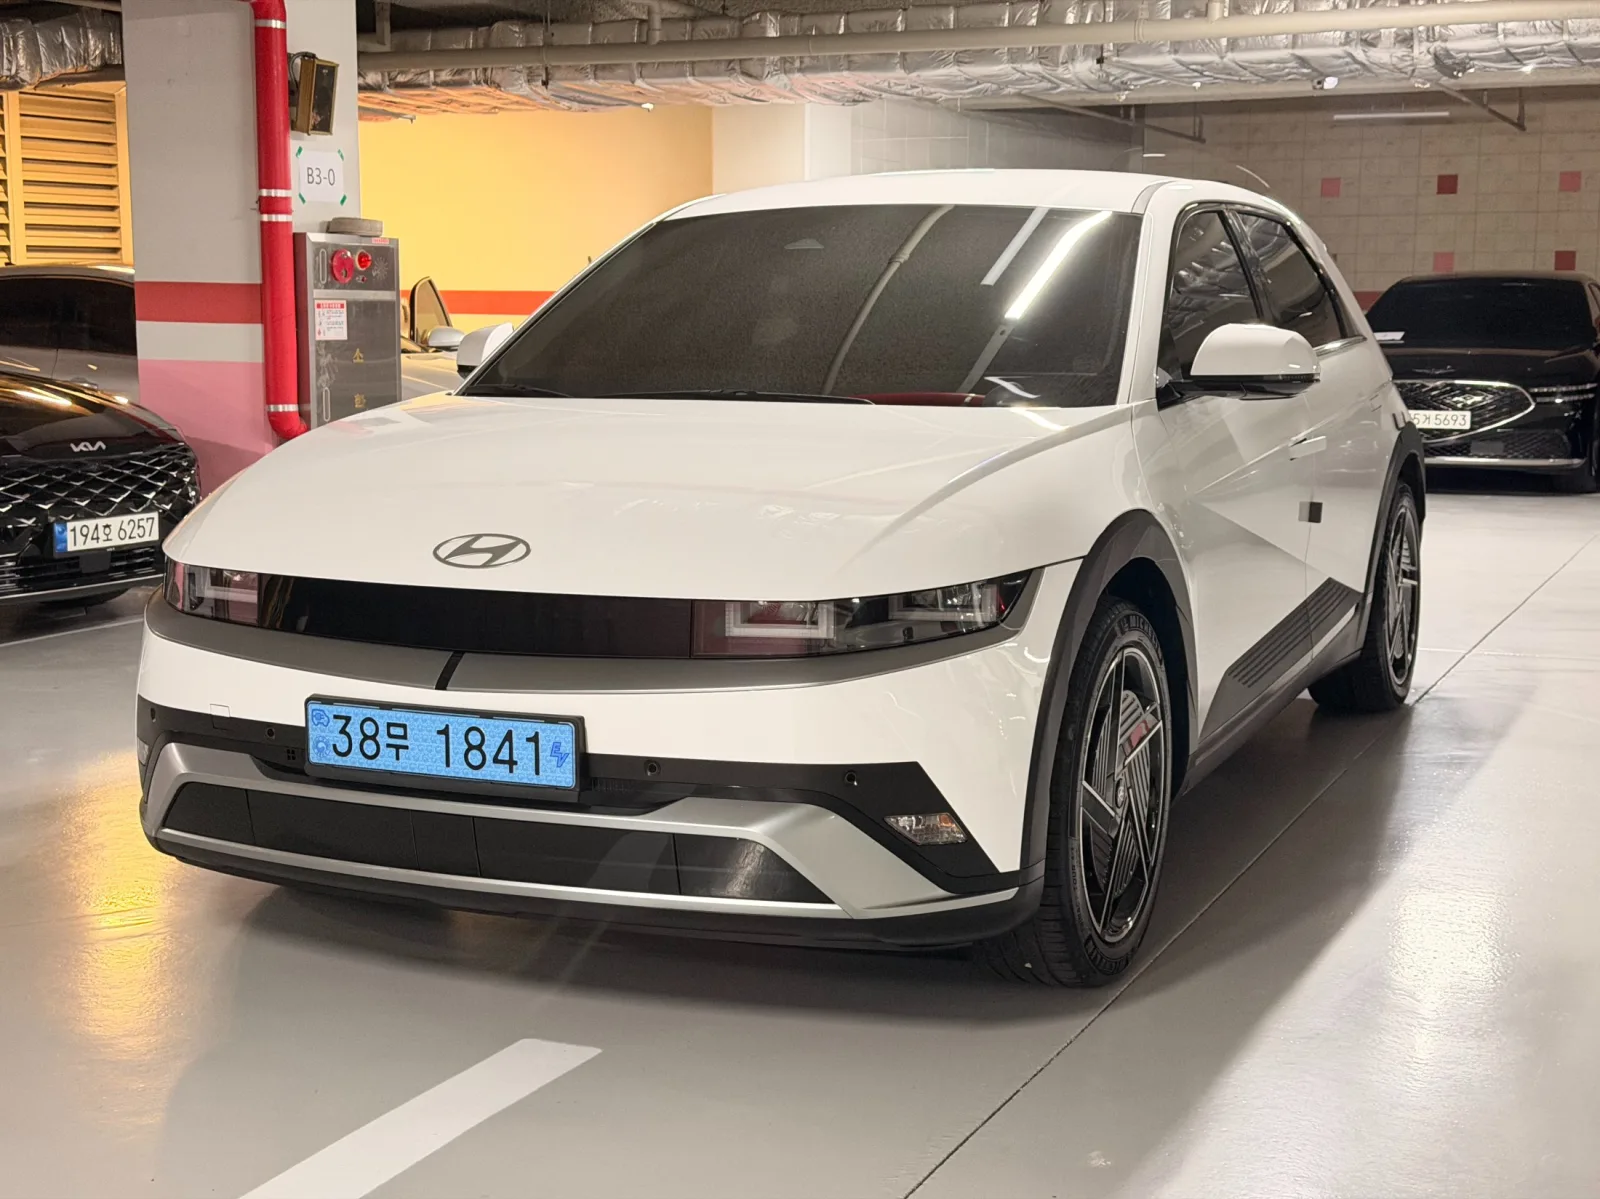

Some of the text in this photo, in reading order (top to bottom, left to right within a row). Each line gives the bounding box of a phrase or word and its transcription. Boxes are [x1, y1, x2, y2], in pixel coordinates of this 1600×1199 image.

[1434, 413, 1467, 427] 5693
[70, 440, 107, 452] KIA
[69, 516, 155, 547] 194호 6257
[332, 714, 541, 776] 38무 1841
[550, 741, 570, 768] EV
